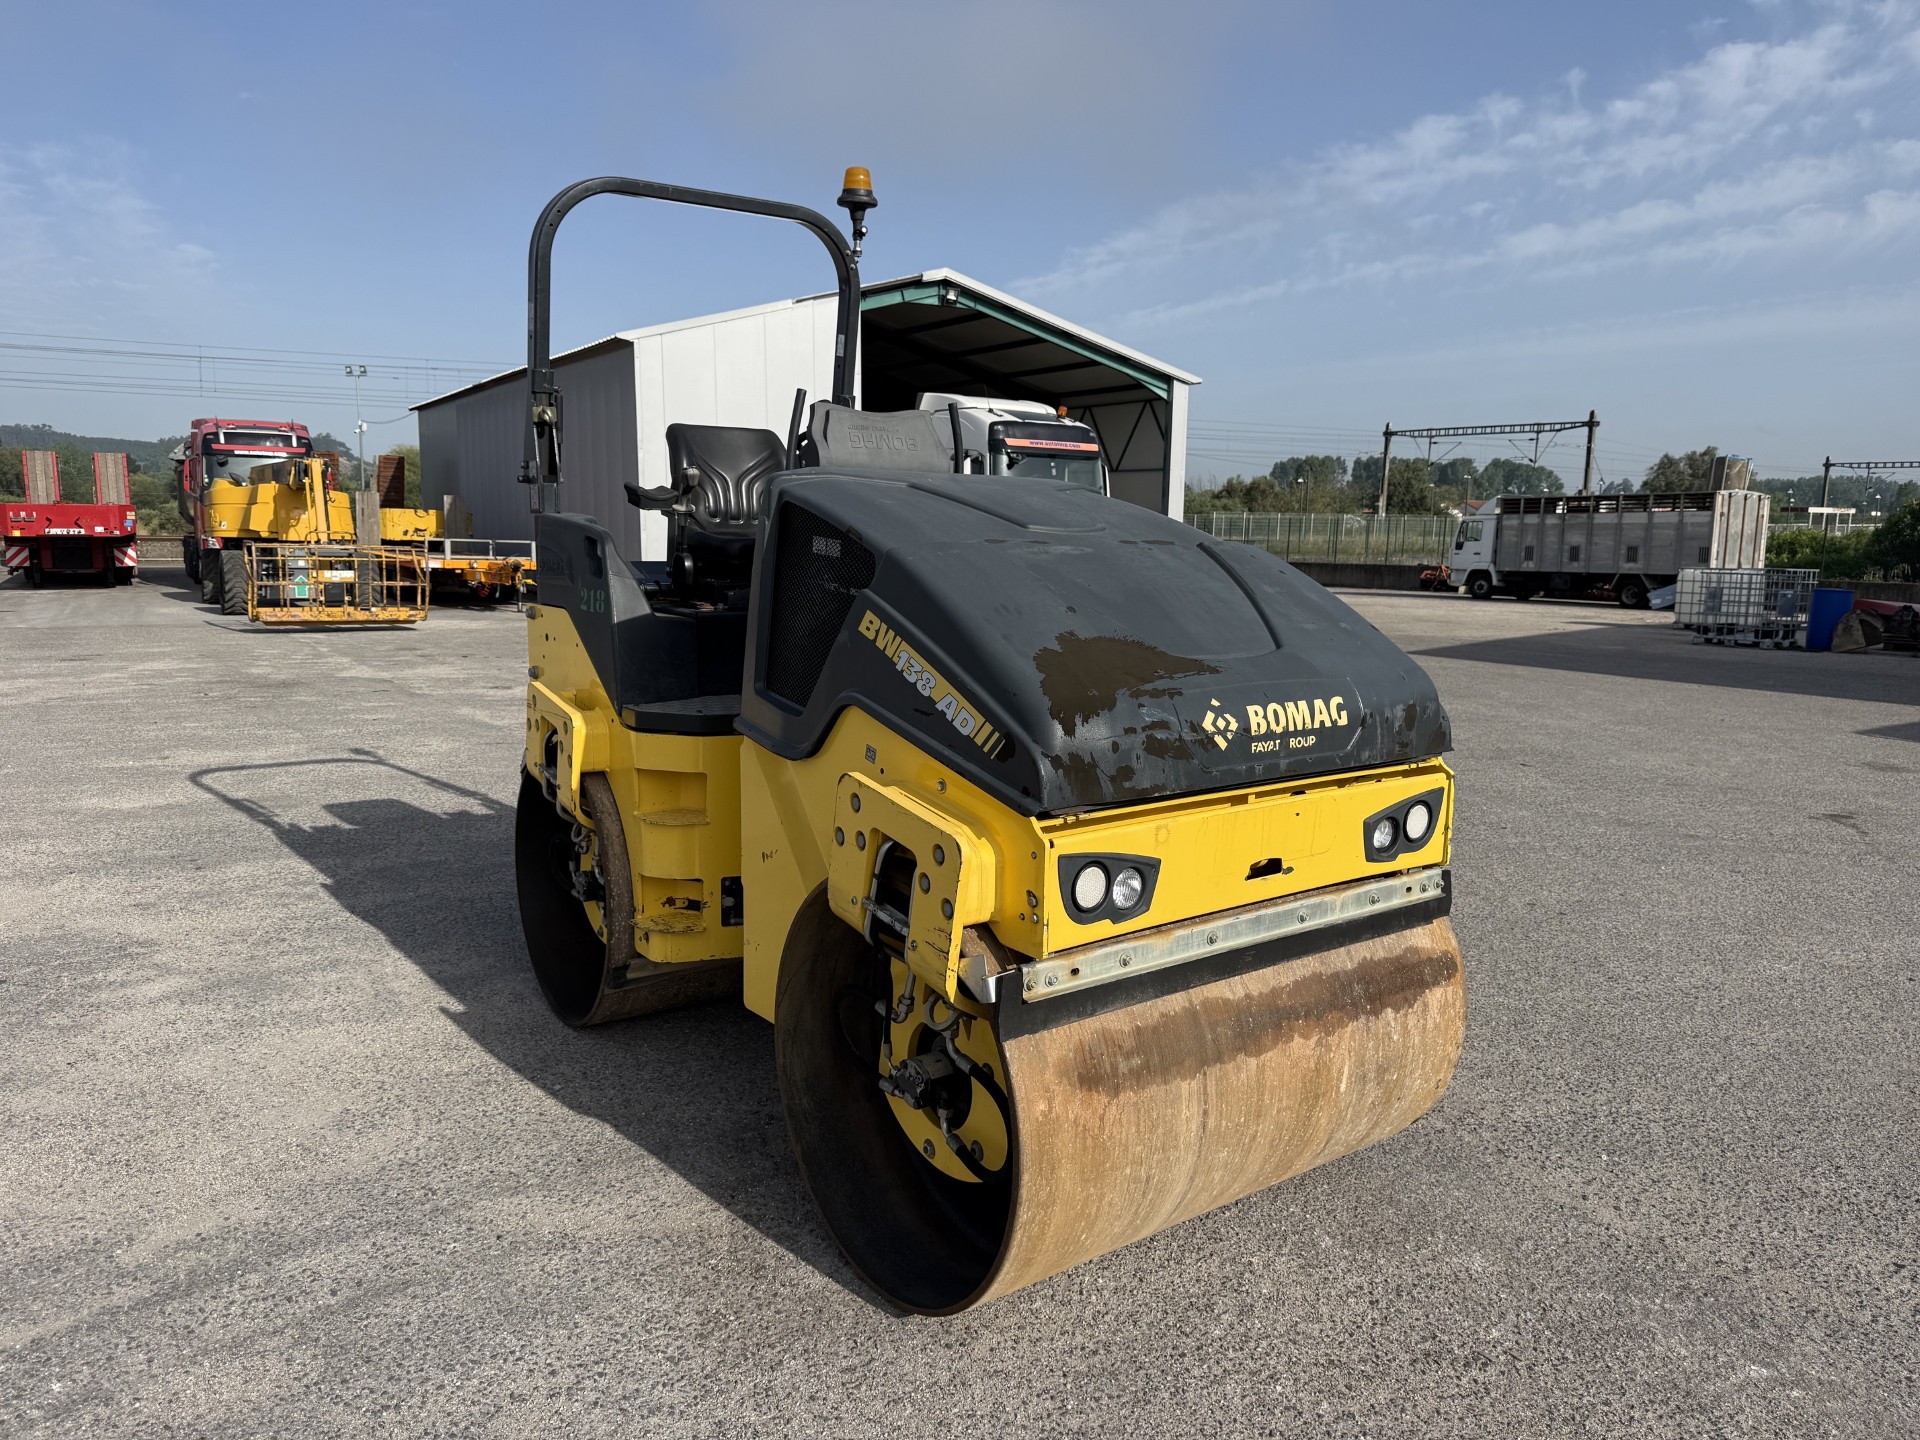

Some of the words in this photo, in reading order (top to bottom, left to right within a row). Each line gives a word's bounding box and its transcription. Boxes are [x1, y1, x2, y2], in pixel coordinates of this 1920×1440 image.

[580, 587, 605, 613] 218
[895, 650, 937, 697] 138
[935, 692, 976, 736] AD
[1246, 696, 1348, 736] BOMAG
[1251, 739, 1281, 754] FAYAT
[1289, 735, 1316, 749] ROUP
